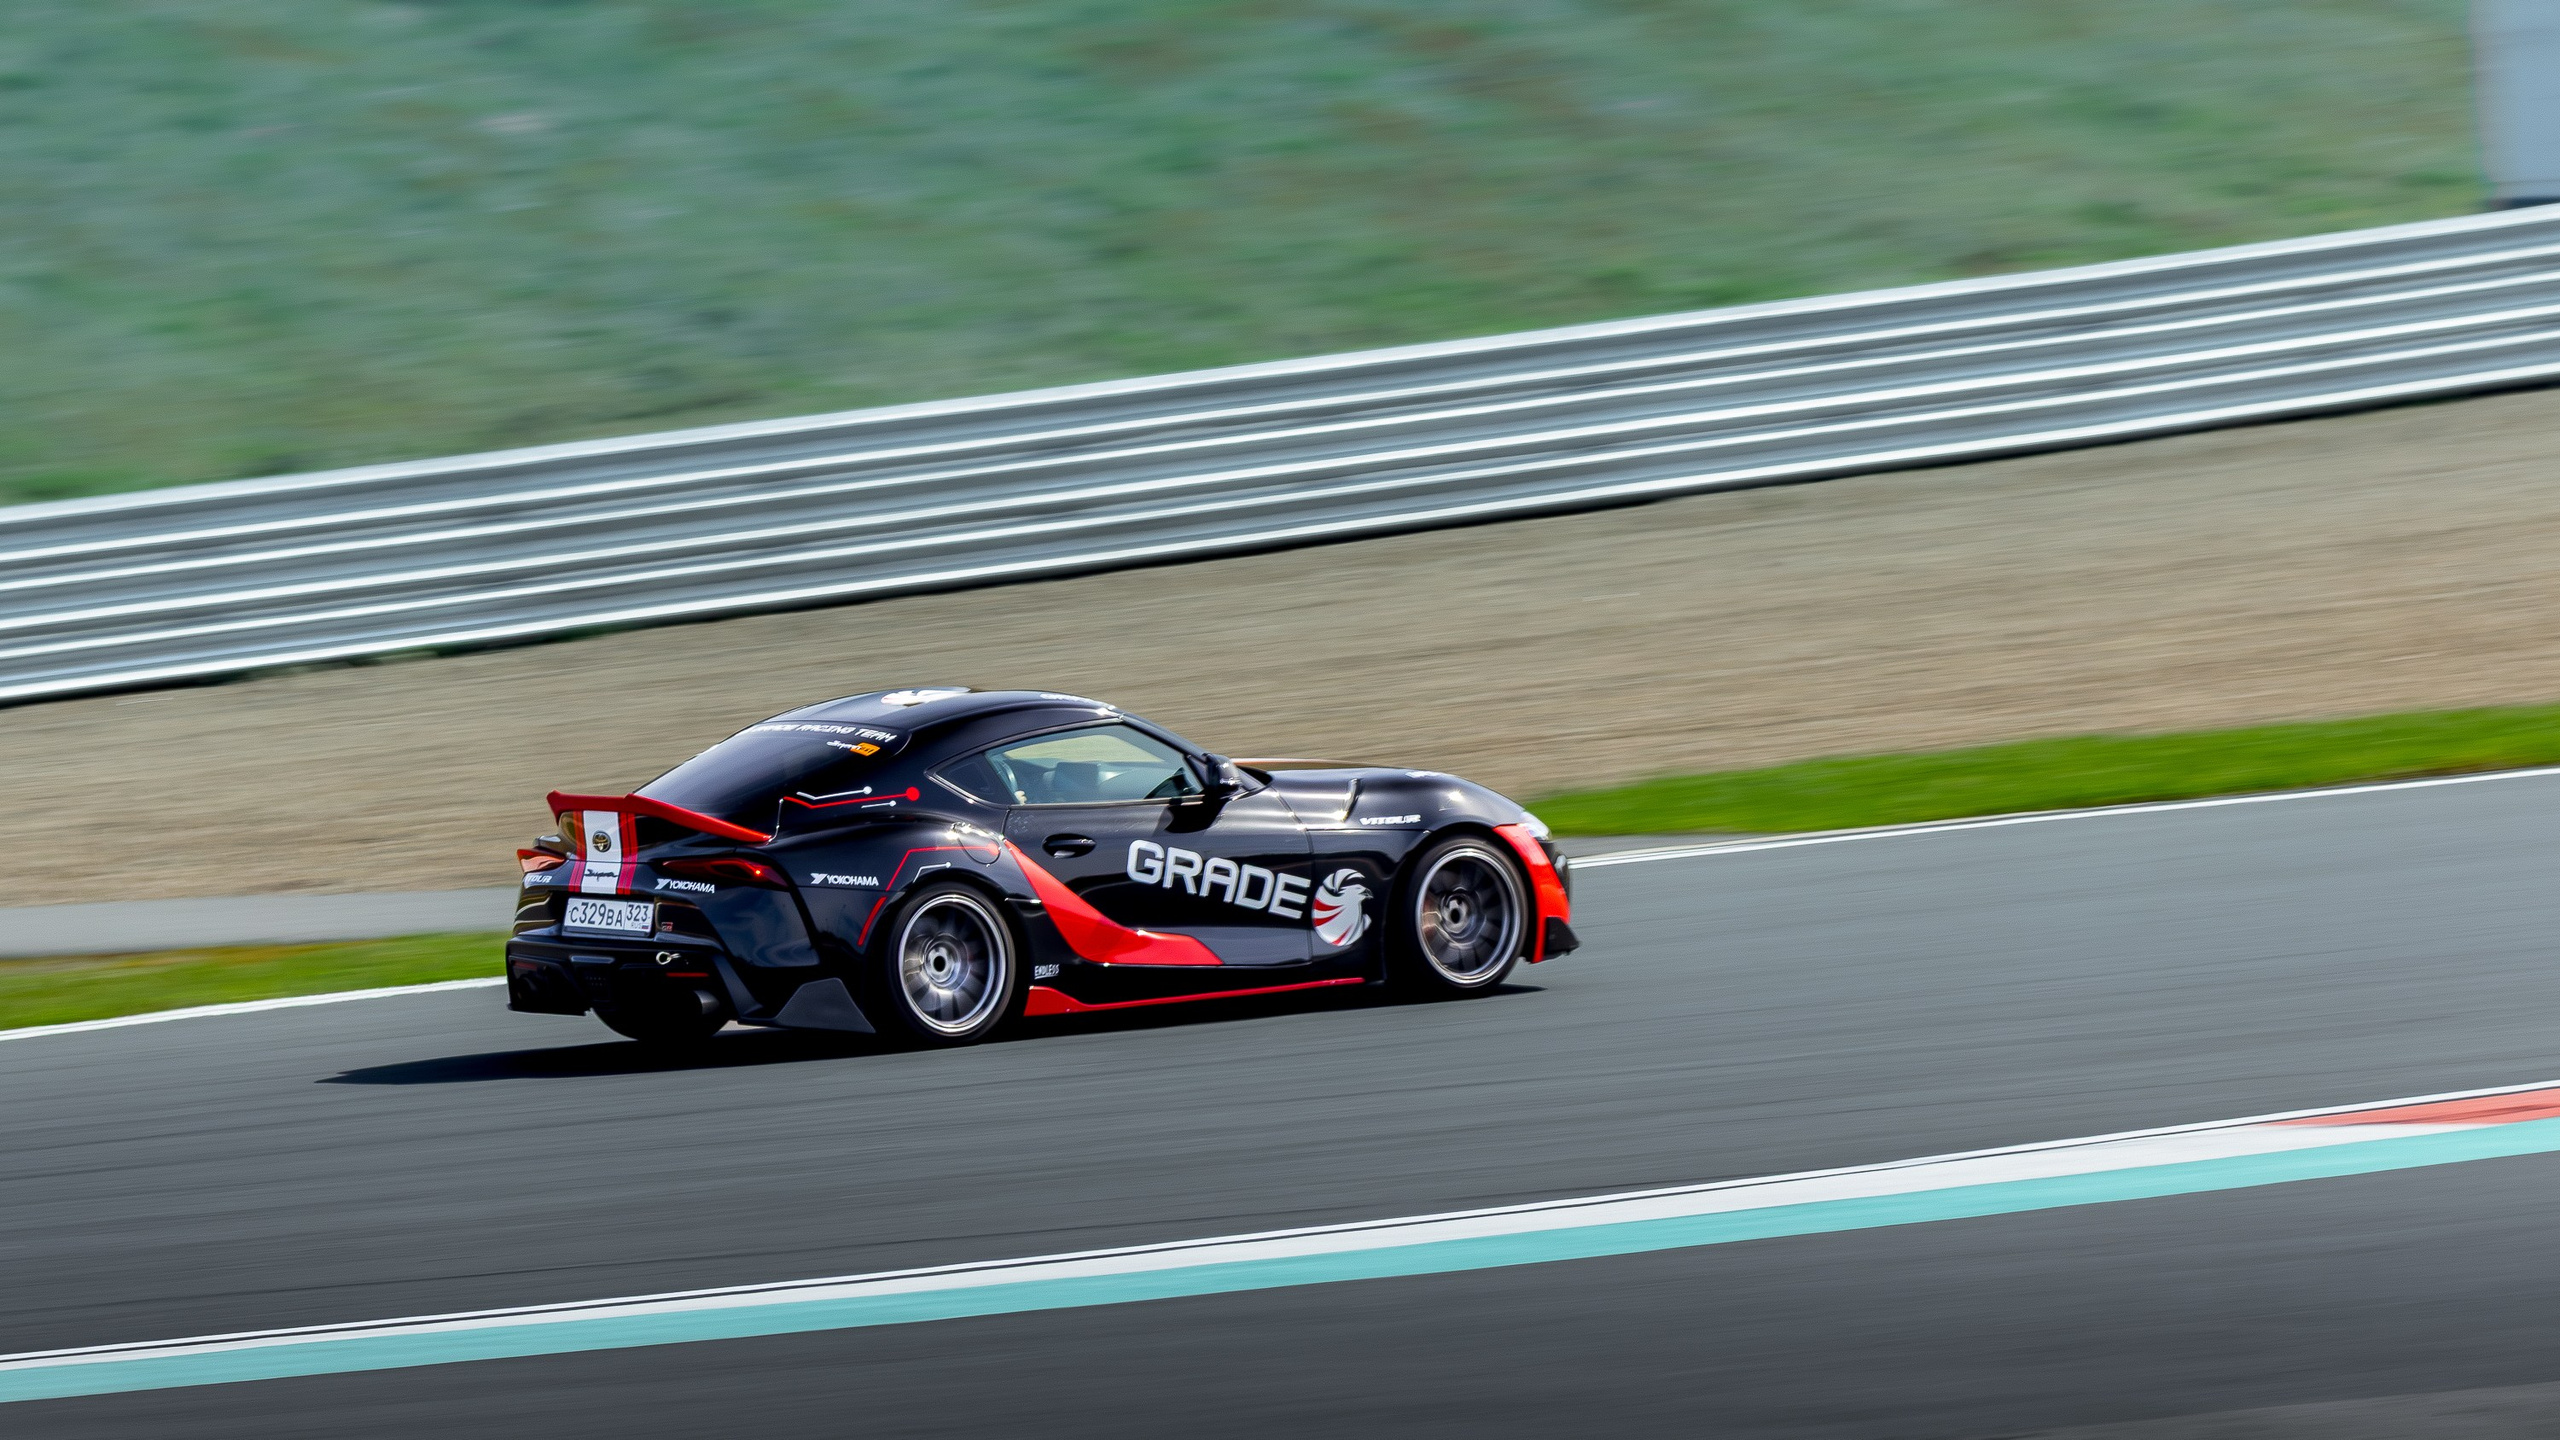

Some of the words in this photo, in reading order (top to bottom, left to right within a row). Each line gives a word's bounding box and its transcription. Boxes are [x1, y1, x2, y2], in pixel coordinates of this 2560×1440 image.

[797, 724, 856, 735] RACING
[855, 728, 898, 743] TEAM
[669, 879, 715, 894] YOKOHAMA
[826, 874, 879, 886] YOKOHAMA
[1127, 839, 1311, 919] GRADE
[570, 902, 623, 927] C329BA
[626, 904, 649, 922] 323
